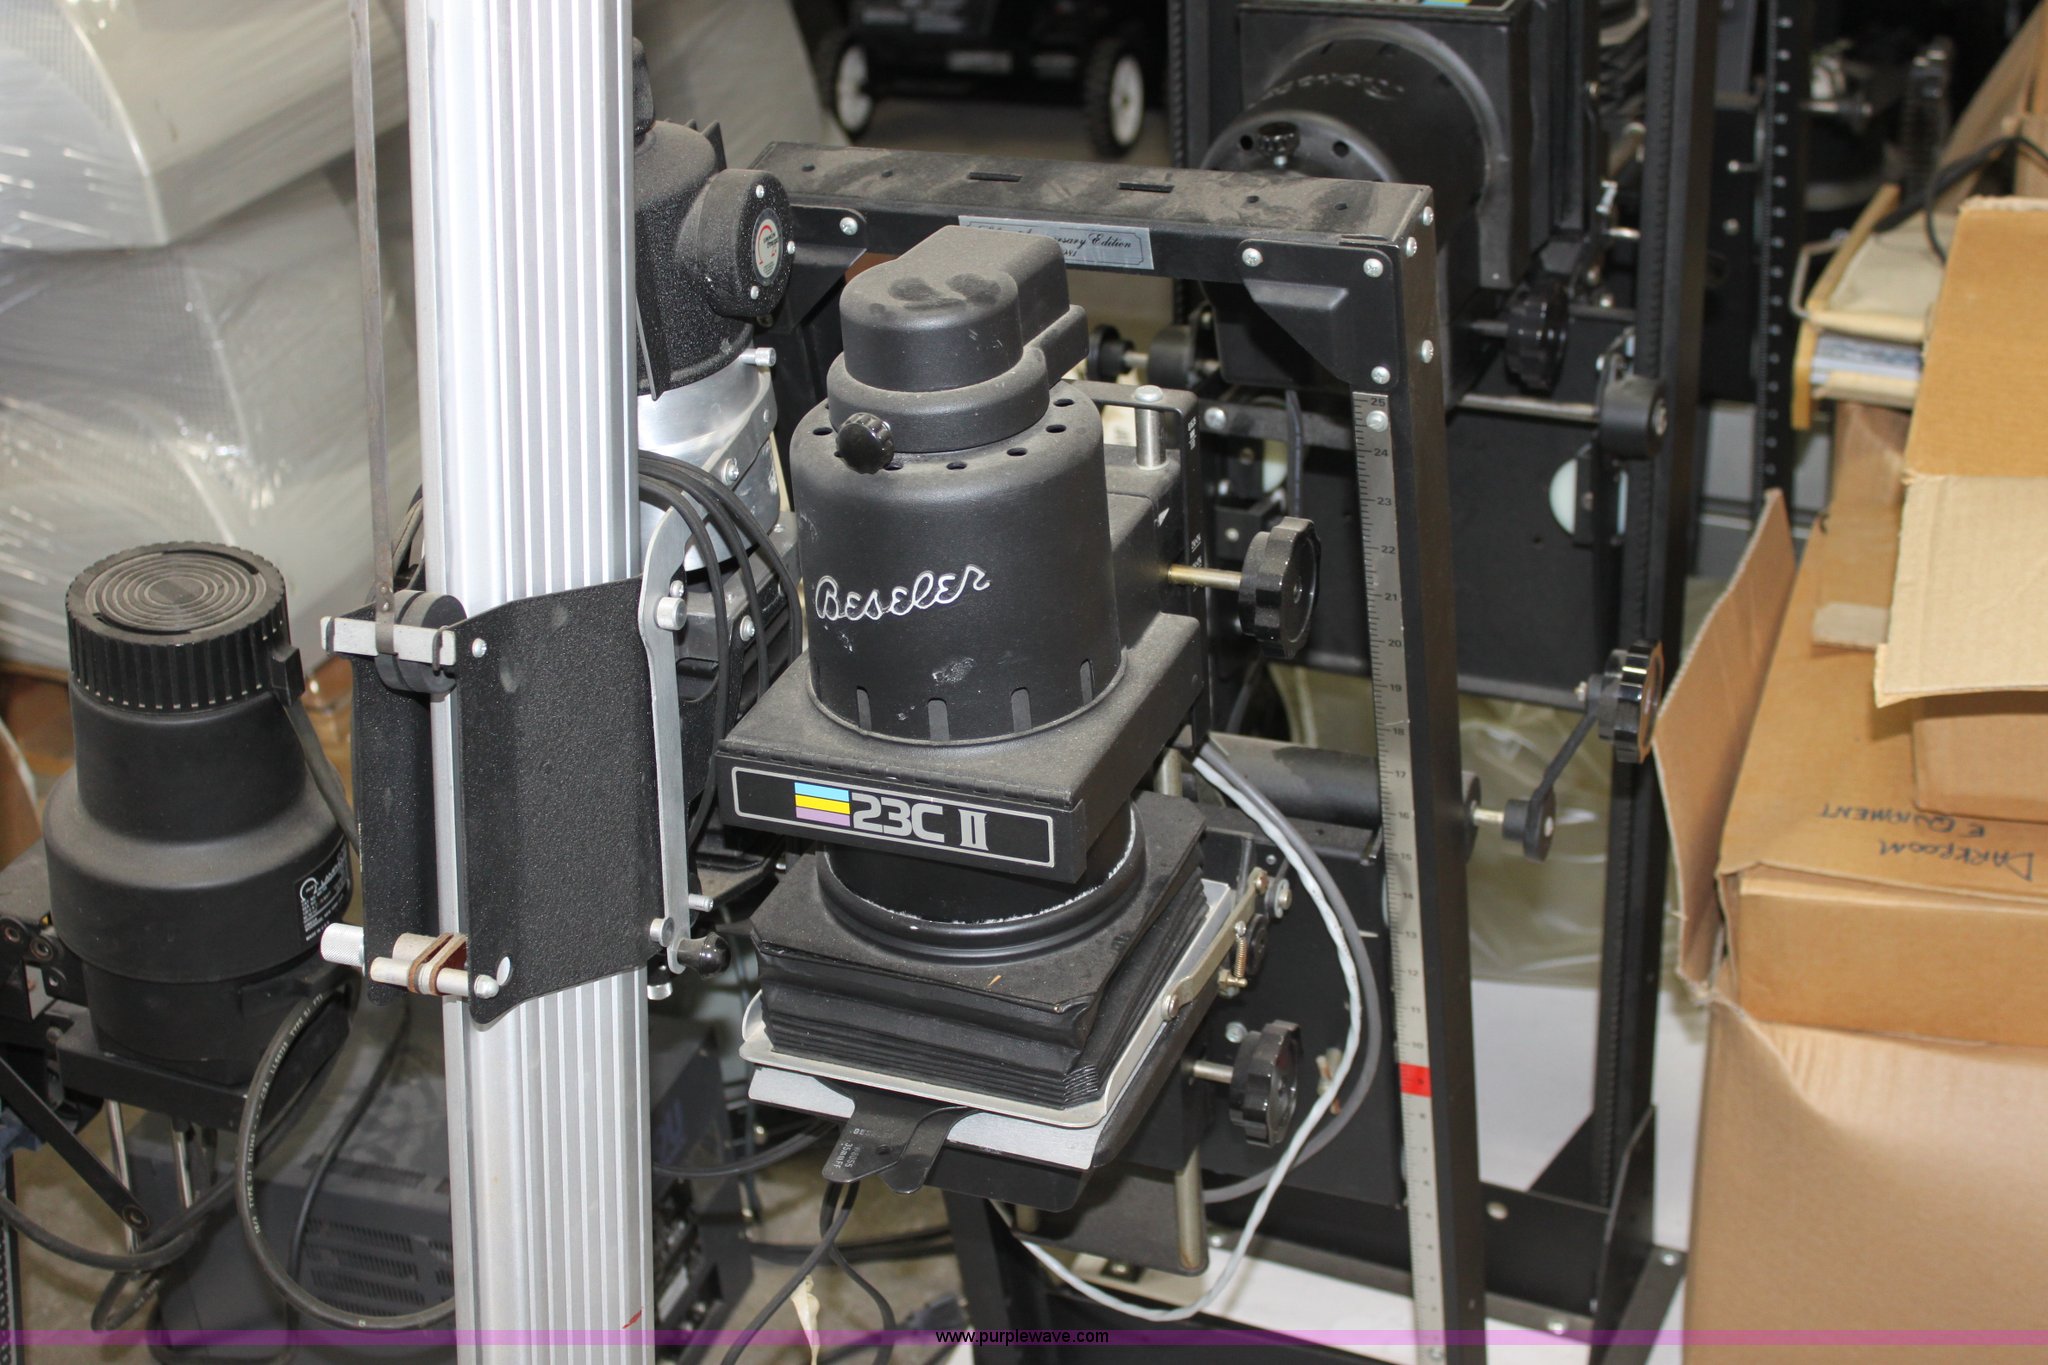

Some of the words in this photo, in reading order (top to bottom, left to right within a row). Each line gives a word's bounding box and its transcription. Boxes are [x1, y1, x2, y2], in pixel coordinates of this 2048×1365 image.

[1087, 232, 1132, 248] Edition
[1370, 397, 1386, 407] 25
[1373, 448, 1388, 457] 24
[1377, 497, 1392, 506] 23
[1381, 545, 1396, 555] 22
[1384, 592, 1398, 601] 21
[1388, 639, 1402, 648] 20
[1390, 684, 1402, 693] 19
[851, 792, 945, 843] 23C
[957, 808, 990, 851] II
[289, 1017, 304, 1036] TYPE
